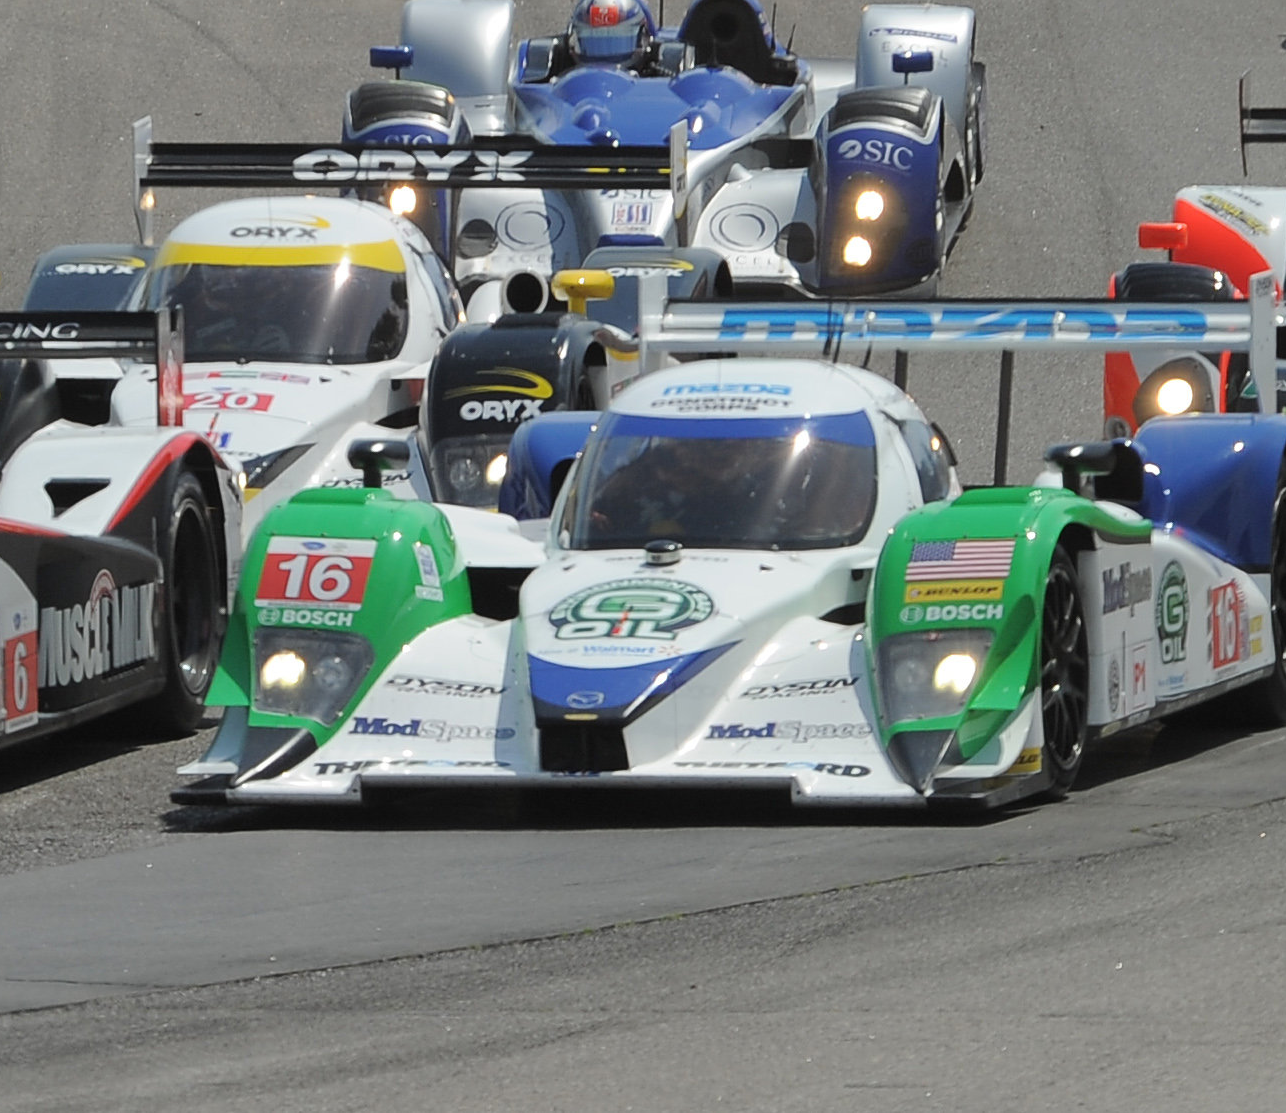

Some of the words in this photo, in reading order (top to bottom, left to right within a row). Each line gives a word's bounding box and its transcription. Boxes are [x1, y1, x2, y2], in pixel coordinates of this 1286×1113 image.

[292, 149, 534, 181] ORYX
[864, 139, 914, 171] SIC
[230, 227, 318, 239] ORYX
[55, 263, 135, 275] ORYX
[606, 267, 685, 278] ORYX
[188, 392, 260, 410] 20
[459, 398, 545, 422] ORYX
[650, 396, 794, 408] CONSTRUCT
[677, 404, 760, 413] CORPS
[278, 554, 354, 602] 16
[924, 586, 999, 597] DUNLOP
[1102, 561, 1152, 618] ModSpace
[579, 588, 686, 621] G
[925, 604, 1004, 621] BOSCH
[1164, 584, 1185, 634] G
[281, 609, 354, 627] BOSCH
[1216, 585, 1238, 662] 16
[37, 597, 111, 688] MUSCLE
[111, 582, 156, 670] MILK
[556, 619, 678, 641] OIL
[582, 644, 657, 655] Walmart
[1161, 637, 1186, 665] OIL
[13, 640, 28, 712] 6
[386, 675, 508, 695] DYSON
[741, 676, 862, 697] DYSON
[396, 688, 483, 698] RACING
[751, 688, 837, 700] RACING
[348, 716, 516, 743] ModSpace
[703, 720, 874, 744] ModSpace
